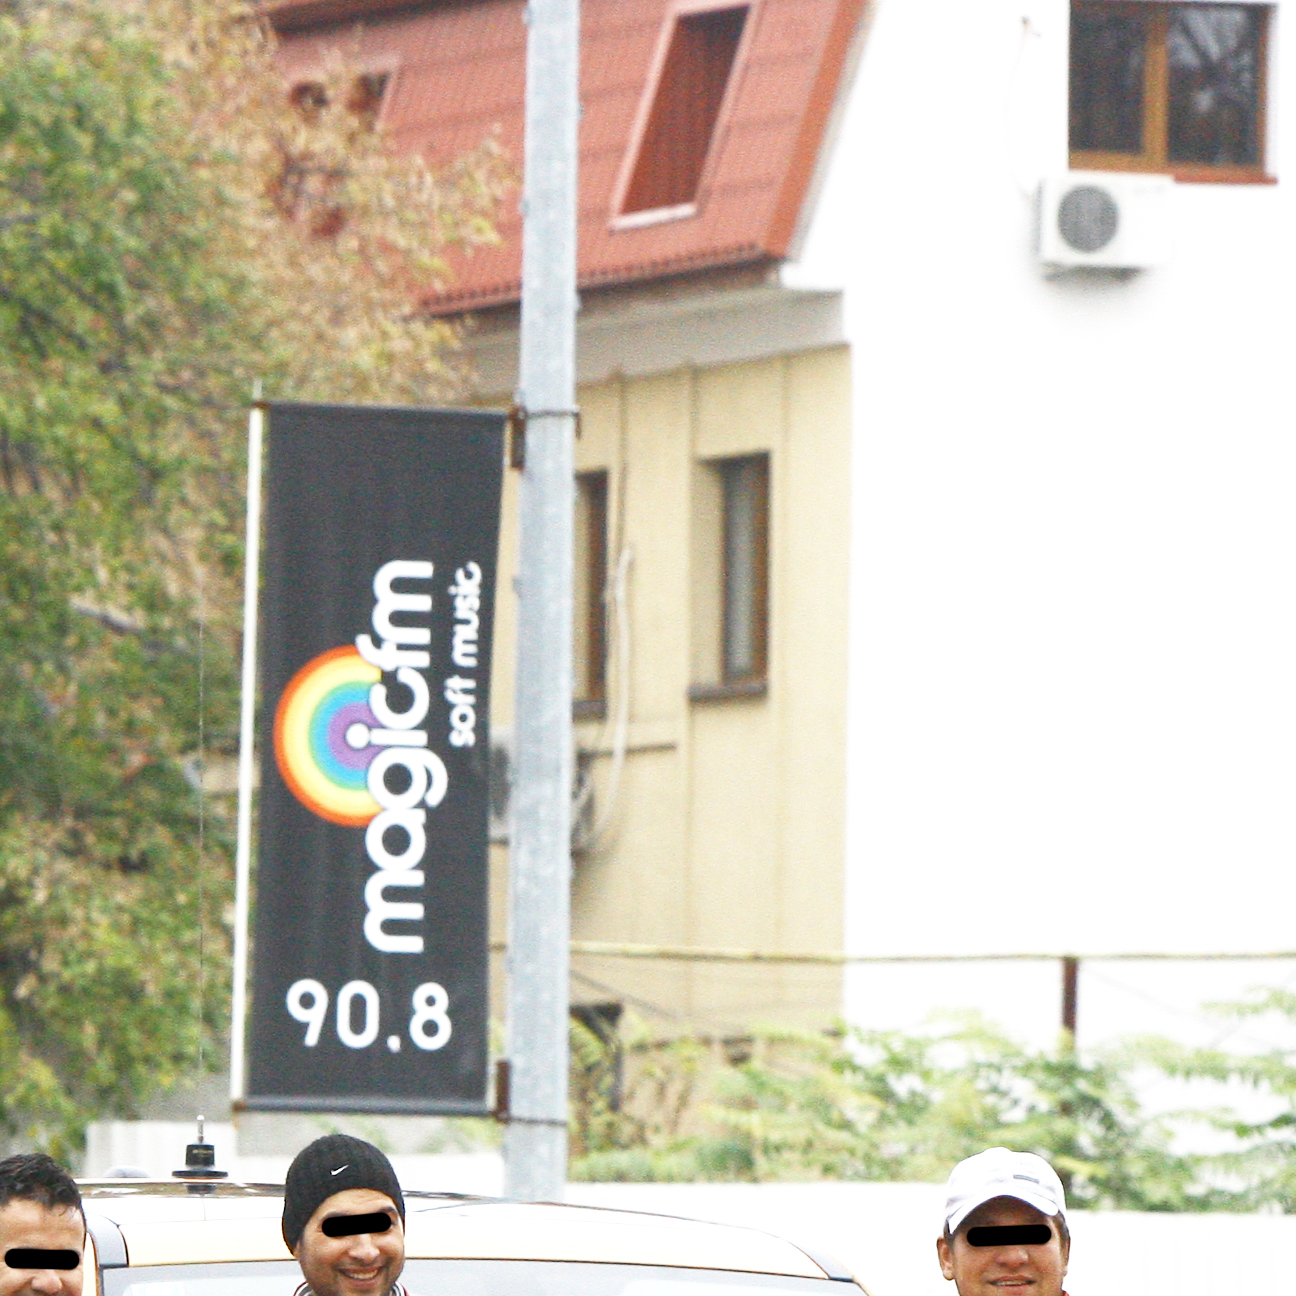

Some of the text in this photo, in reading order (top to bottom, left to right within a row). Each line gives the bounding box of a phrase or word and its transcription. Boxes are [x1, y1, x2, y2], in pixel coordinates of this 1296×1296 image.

[445, 561, 482, 747] soft music
[287, 979, 452, 1051] 90.8
